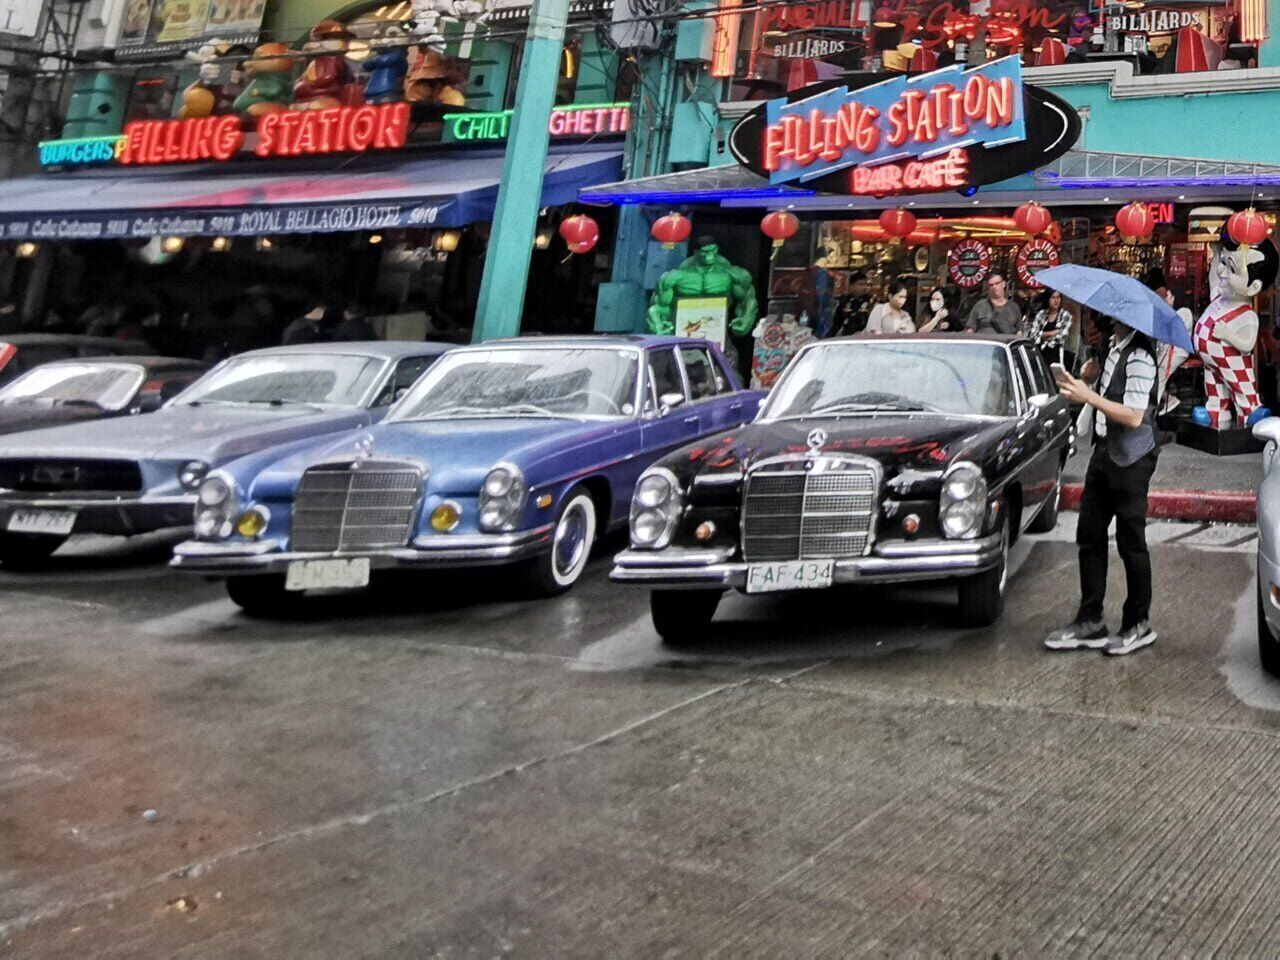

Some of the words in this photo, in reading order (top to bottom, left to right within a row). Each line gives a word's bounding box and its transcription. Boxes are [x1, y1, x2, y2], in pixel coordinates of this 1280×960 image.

[1111, 9, 1201, 33] BILLIARDS
[773, 37, 846, 59] BILLIARDS
[548, 107, 632, 135] GHETTI
[763, 100, 882, 172] FILLING
[886, 73, 1014, 146] STATION
[121, 115, 243, 165] FILLING
[256, 102, 411, 157] STATION
[38, 141, 115, 166] BURGERS
[853, 164, 903, 194] BAR
[238, 212, 283, 232] ROYAL
[285, 208, 354, 231] BELLAGIO
[354, 206, 402, 227] HOTEL
[1149, 202, 1175, 224] EN
[951, 240, 989, 261] FILLING
[1019, 240, 1059, 261] FILLING
[950, 265, 989, 286] STATION
[793, 563, 831, 581] 434
